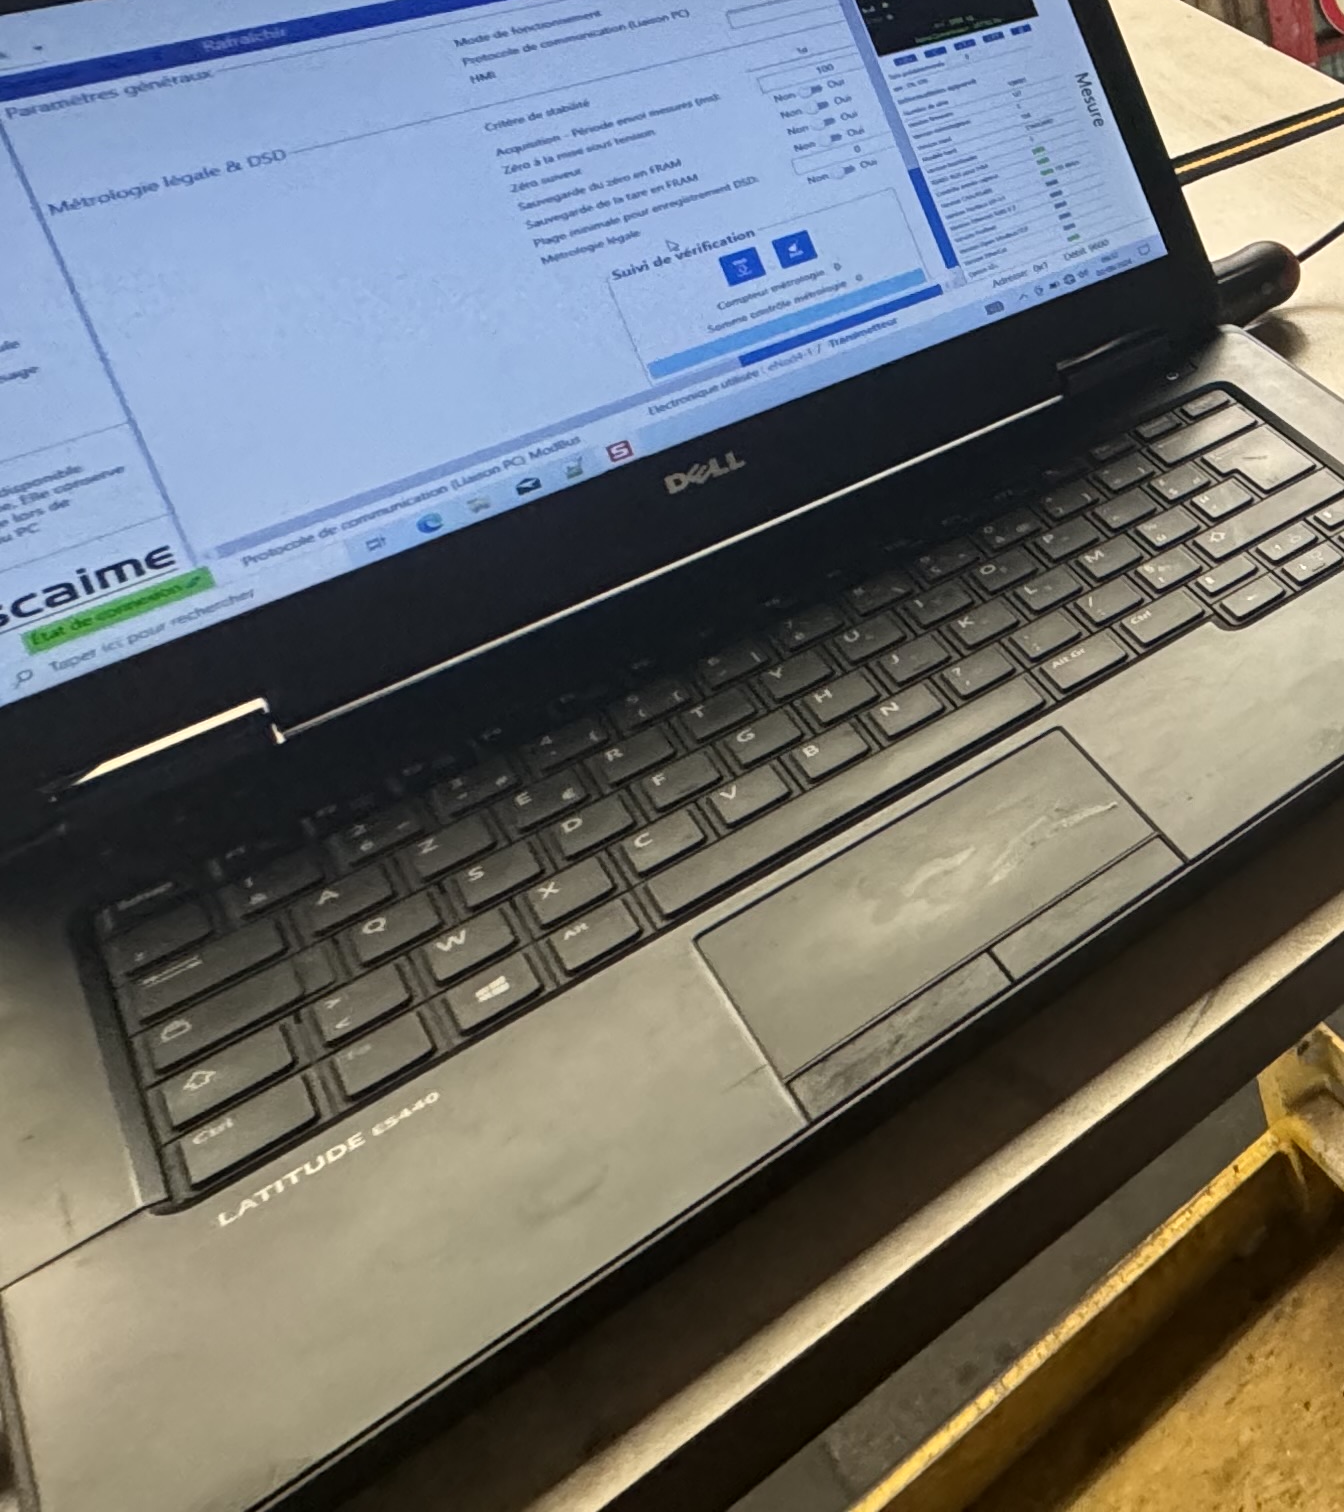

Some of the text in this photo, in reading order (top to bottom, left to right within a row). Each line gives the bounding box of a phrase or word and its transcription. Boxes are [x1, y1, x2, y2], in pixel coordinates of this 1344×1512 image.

[492, 25, 509, 39] de
[522, 41, 538, 53] de
[4, 70, 215, 120] Paramètres généraux
[527, 109, 544, 122] de
[1075, 72, 1105, 128] Mesure
[47, 148, 288, 217] Métrologie légale & DSD
[649, 157, 683, 176] FRAM
[665, 172, 700, 190] FRAM
[611, 227, 757, 282] Suivi de vérification
[663, 450, 748, 496] DELL
[241, 532, 316, 568] Protocole
[317, 524, 339, 540] de
[339, 486, 450, 532] communication
[48, 647, 97, 674] Taper
[125, 620, 167, 649] pour
[168, 588, 256, 628] rechercher
[1130, 610, 1153, 625] Ctrl
[1052, 647, 1086, 670] Alt Gr
[361, 916, 387, 935] Q
[467, 865, 485, 882] S
[560, 817, 584, 834] D
[651, 771, 667, 787] F
[736, 727, 756, 744] G
[813, 687, 834, 704] H
[956, 614, 976, 629] K
[1023, 585, 1040, 596] L
[1083, 548, 1106, 564] M
[315, 889, 339, 906] A
[417, 837, 440, 856] Z
[515, 790, 533, 807] E
[604, 747, 625, 763] R
[690, 704, 706, 719] T
[435, 929, 468, 953] W
[538, 881, 561, 900] X
[633, 831, 655, 848] C
[720, 784, 738, 800] V
[802, 743, 820, 759] B
[879, 700, 901, 718] N
[562, 921, 591, 941] Alt
[217, 1130, 367, 1228] LATITUDE
